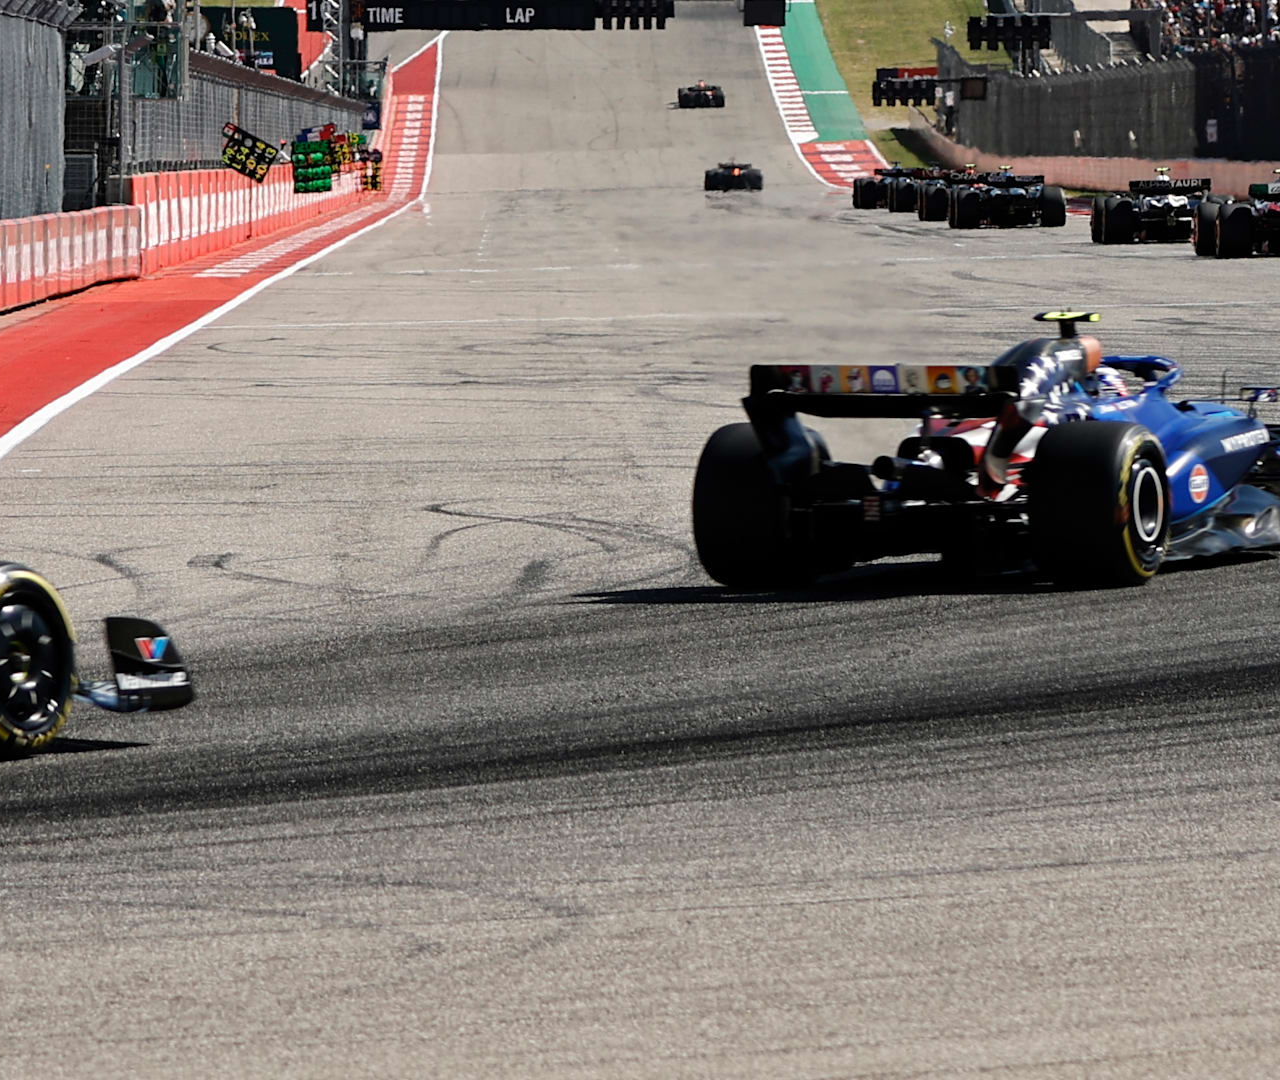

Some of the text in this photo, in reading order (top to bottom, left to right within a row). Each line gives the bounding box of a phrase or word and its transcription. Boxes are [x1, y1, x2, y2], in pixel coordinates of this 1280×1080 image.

[308, 1, 331, 22] 10
[367, 7, 535, 24] TIME LAP
[1139, 179, 1202, 189] ALPHATAURI
